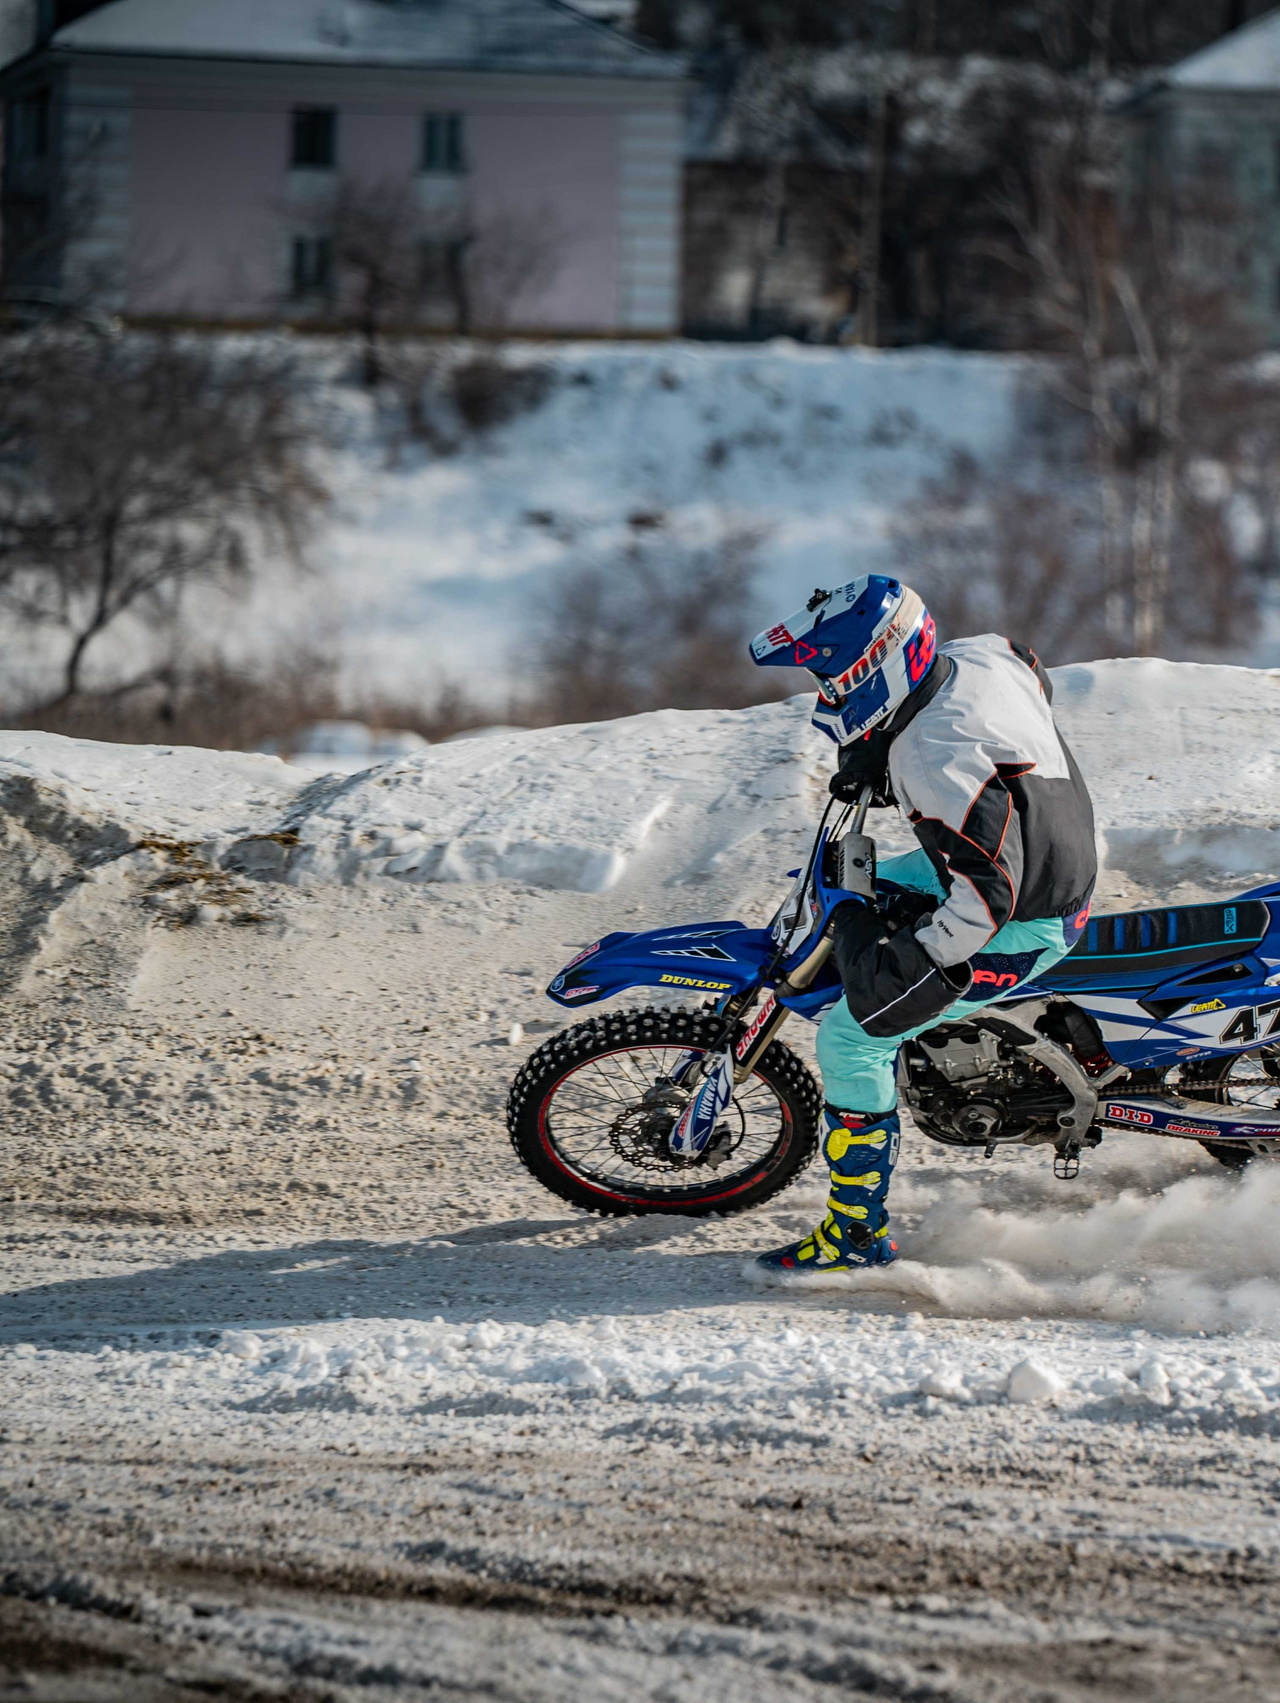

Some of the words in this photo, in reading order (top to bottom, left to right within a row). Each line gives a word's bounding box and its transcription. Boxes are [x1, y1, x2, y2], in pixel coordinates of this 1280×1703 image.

[659, 974, 732, 990] DUNLOP
[697, 1076, 718, 1120] YAMAHA
[1167, 1124, 1219, 1136] BRAKING
